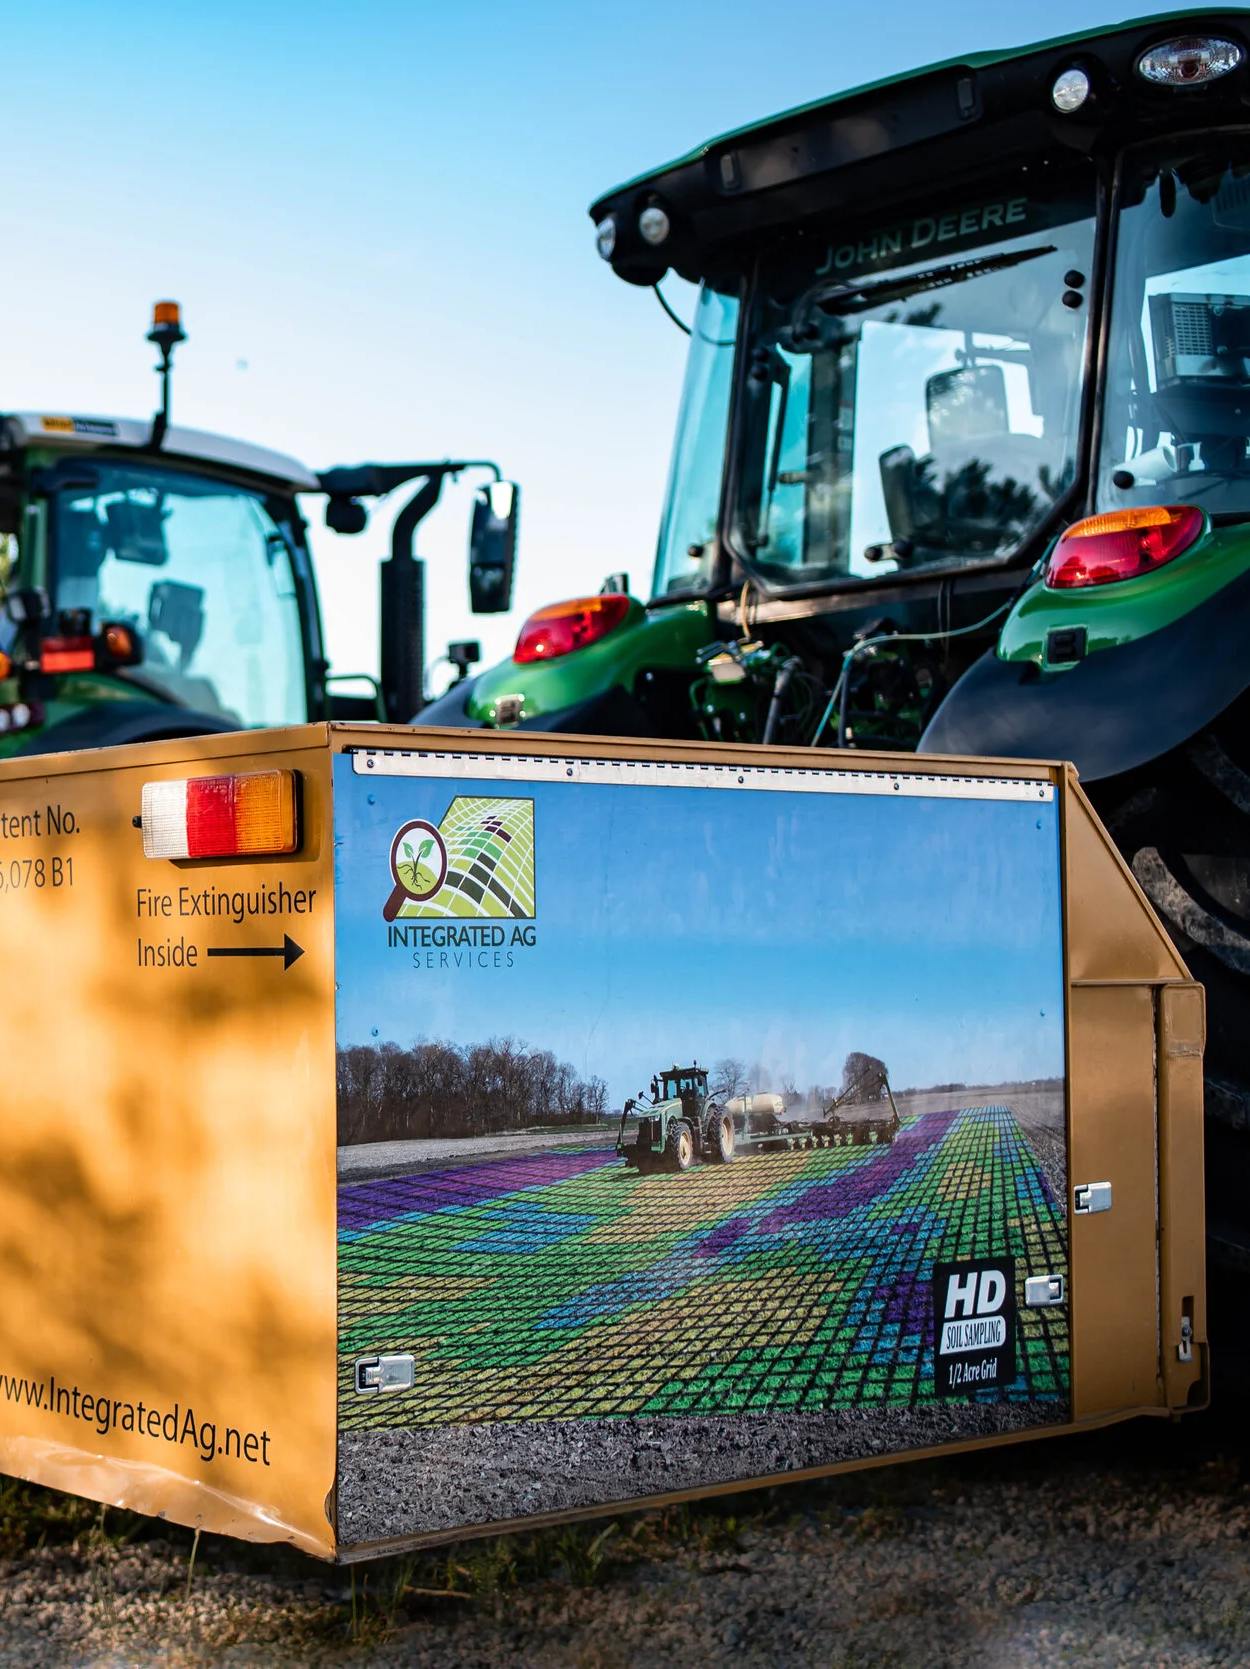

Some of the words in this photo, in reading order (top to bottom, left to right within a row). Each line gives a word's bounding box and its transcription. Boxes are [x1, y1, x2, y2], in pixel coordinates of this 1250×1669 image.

[815, 229, 901, 275] JOHN
[911, 197, 1028, 249] DEERE
[47, 804, 80, 836] No.
[52, 857, 74, 887] B1
[136, 888, 172, 918] Fire
[179, 881, 317, 923] Extinguisher
[388, 925, 505, 947] INTEGRATED
[510, 925, 536, 947] AG
[137, 937, 198, 967] Inside
[413, 951, 514, 969] SERVICES
[944, 1269, 1007, 1319] HD
[946, 1322, 963, 1350] SOIL
[964, 1320, 1001, 1348] SAMPLING
[948, 1362, 962, 1389] 1/2
[963, 1361, 980, 1383] Acre
[981, 1357, 998, 1380] Grid
